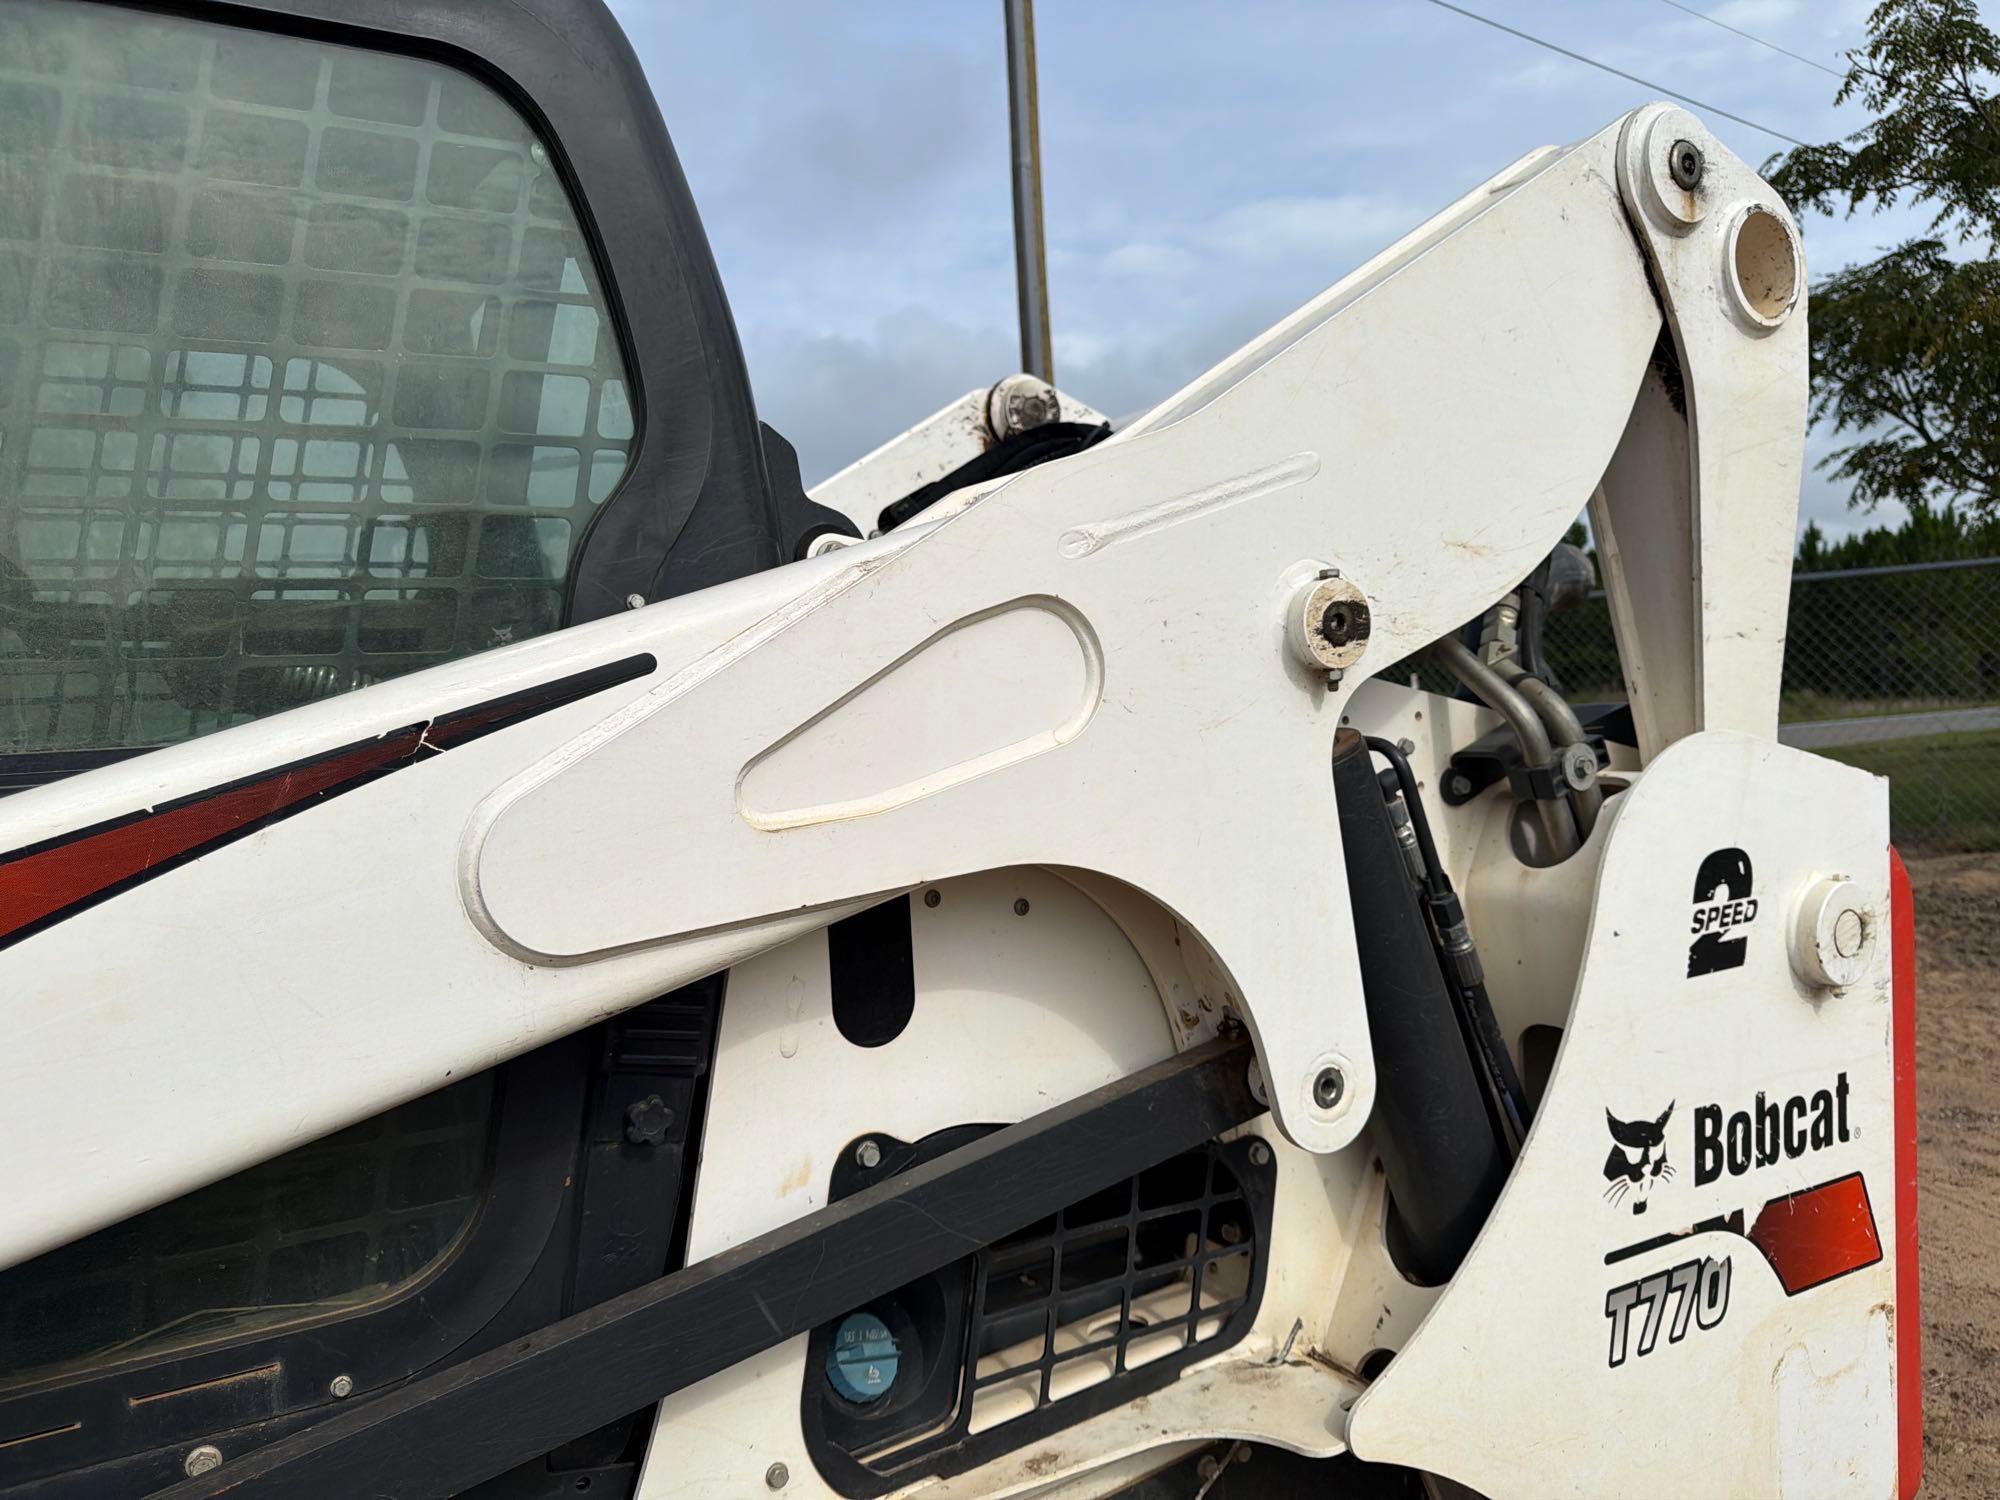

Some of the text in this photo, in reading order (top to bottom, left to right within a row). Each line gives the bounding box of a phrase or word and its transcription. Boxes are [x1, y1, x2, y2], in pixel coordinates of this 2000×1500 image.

[1687, 847, 1753, 978] 2
[1691, 898, 1758, 934] SPEED
[1695, 1072, 1850, 1187] Bobcat
[1605, 1254, 1731, 1368] T770
